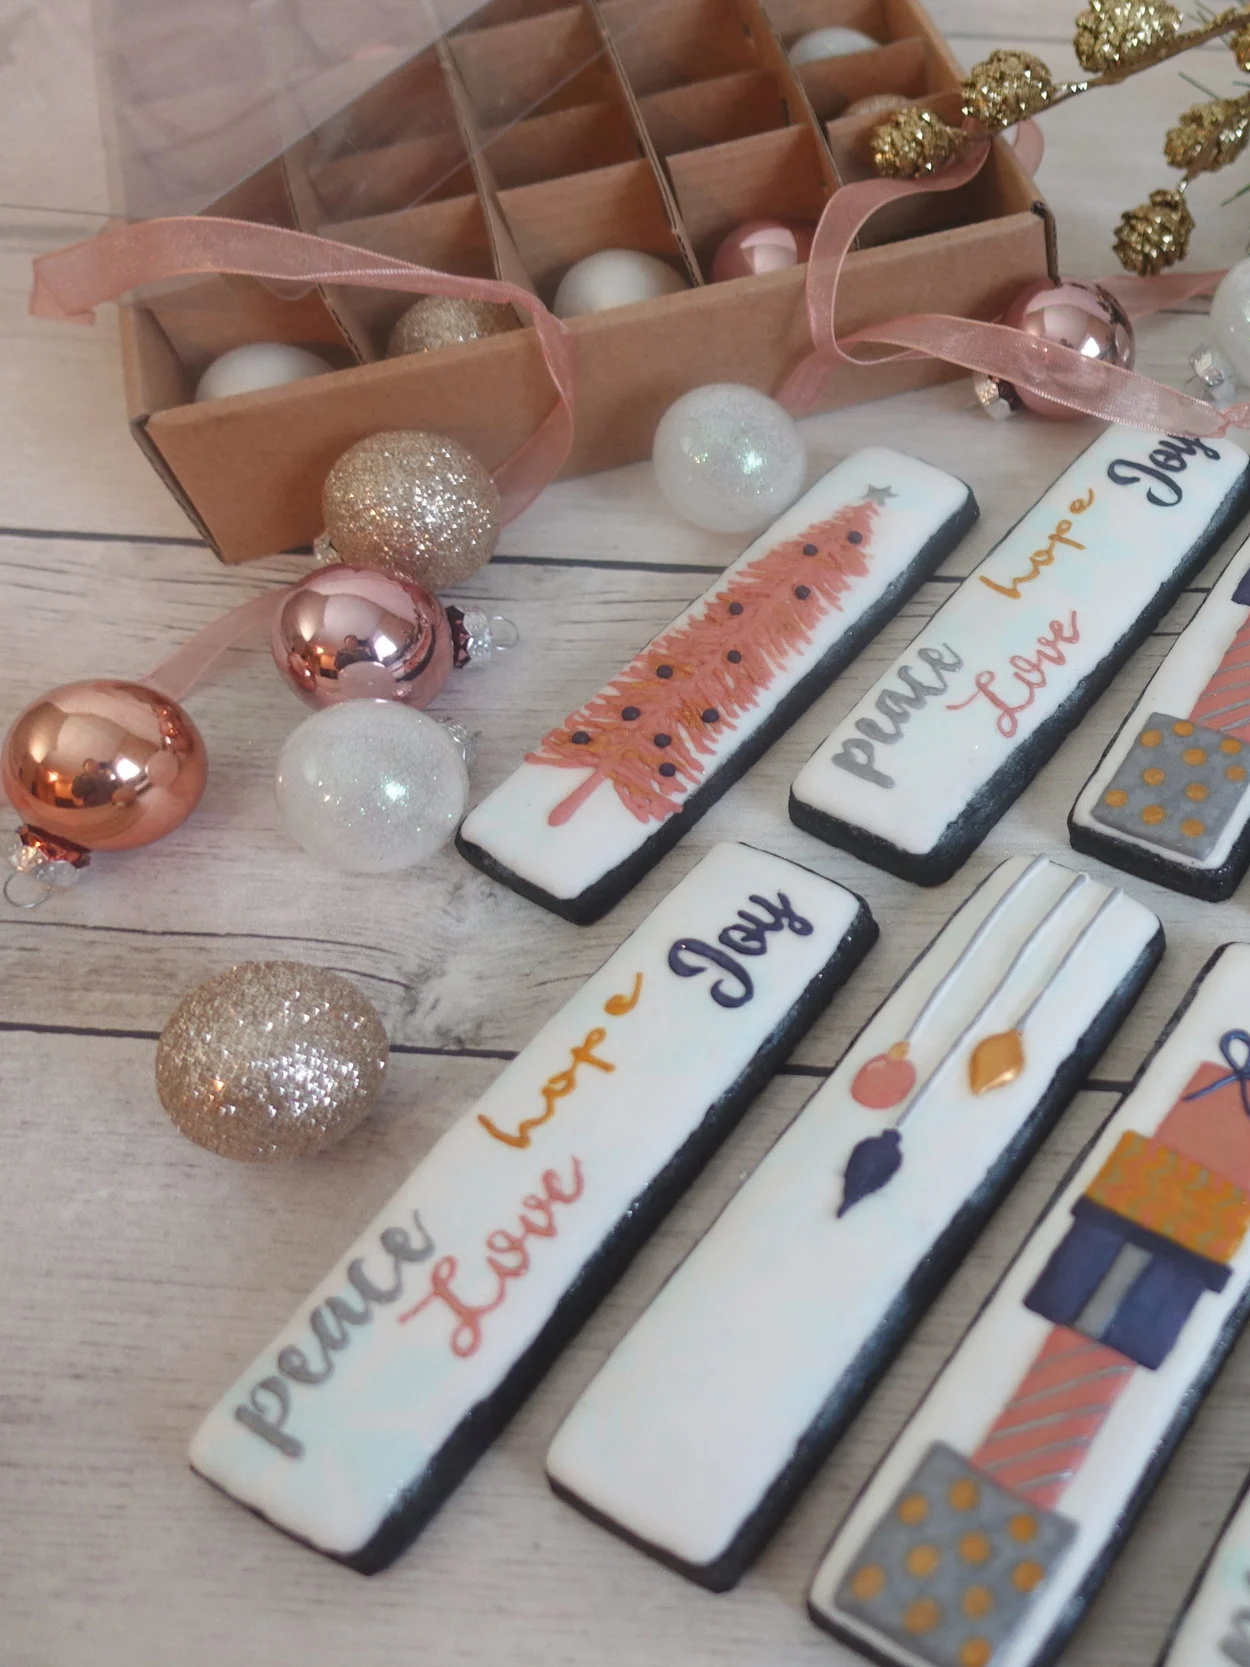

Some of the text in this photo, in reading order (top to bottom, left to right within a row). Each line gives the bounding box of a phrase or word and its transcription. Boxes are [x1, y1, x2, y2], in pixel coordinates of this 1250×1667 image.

[1107, 434, 1221, 507] Joy
[978, 488, 1095, 600] hope
[831, 642, 964, 789] peace
[945, 610, 1080, 738] Love
[667, 891, 815, 1009] Joy
[477, 971, 644, 1150] hope
[397, 1153, 586, 1360] Love
[233, 1208, 437, 1460] peace
